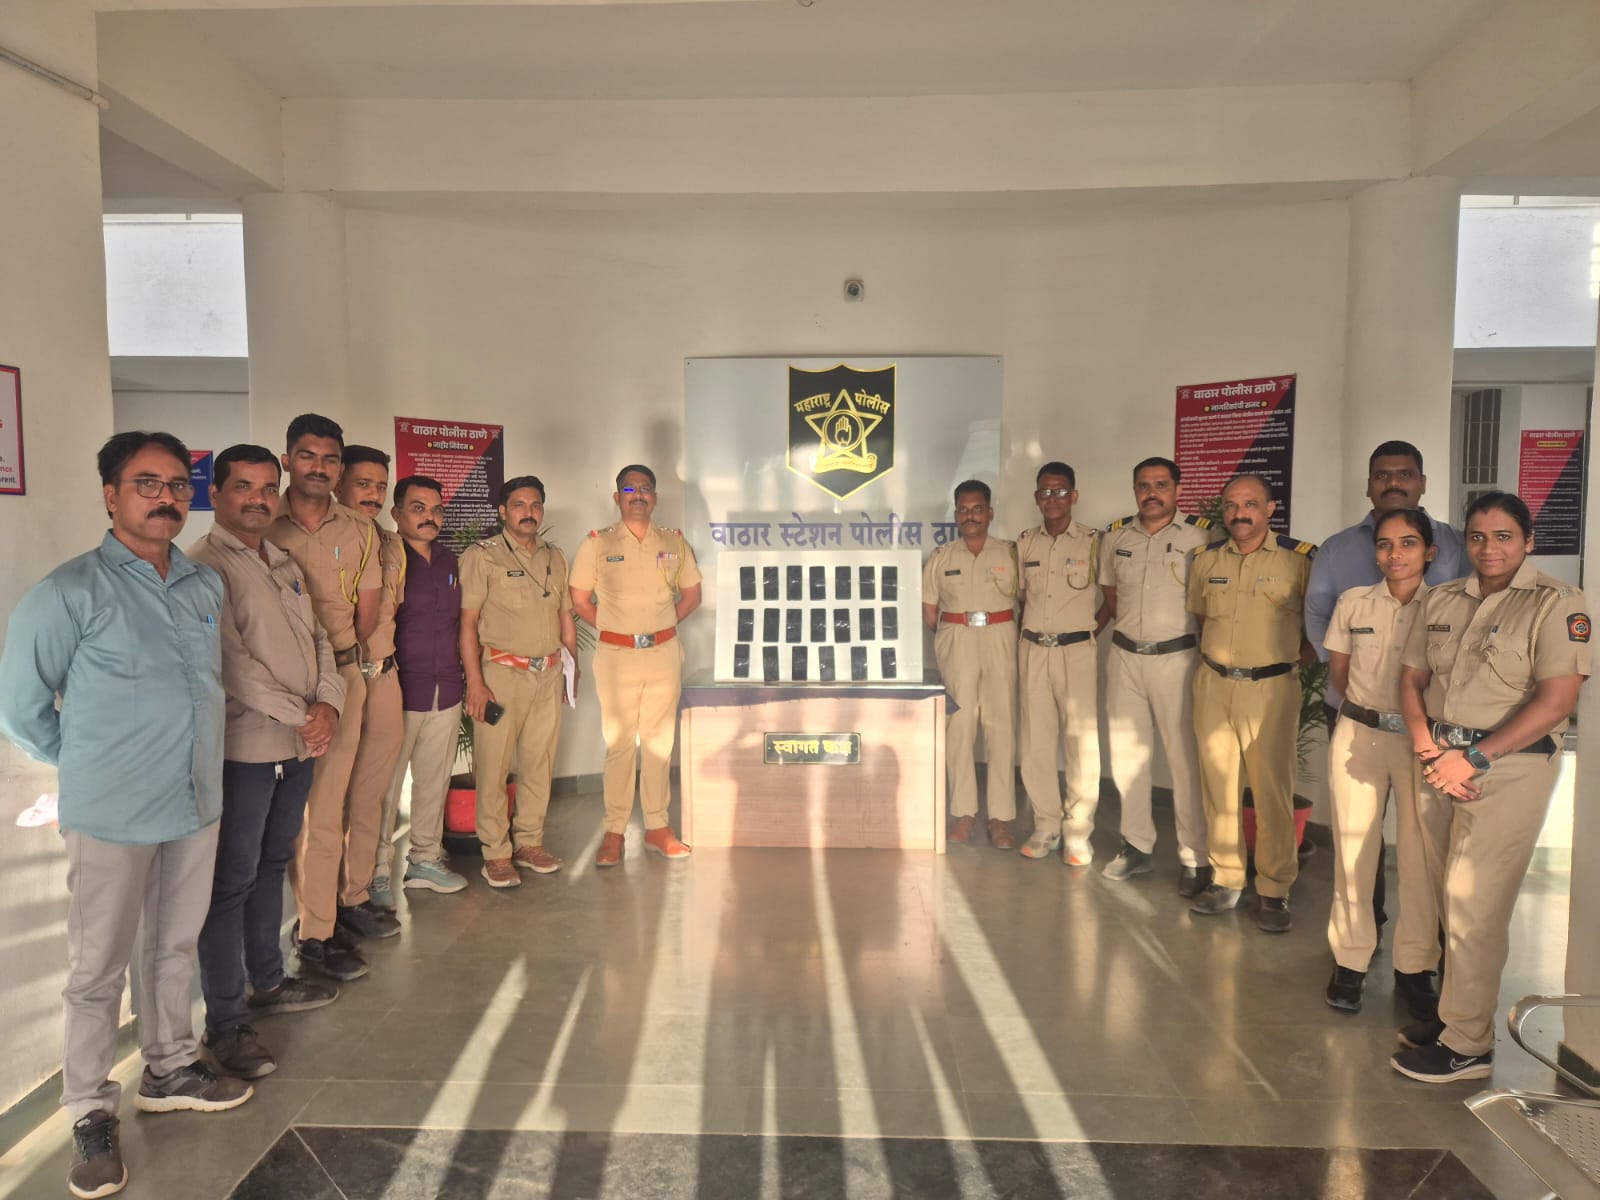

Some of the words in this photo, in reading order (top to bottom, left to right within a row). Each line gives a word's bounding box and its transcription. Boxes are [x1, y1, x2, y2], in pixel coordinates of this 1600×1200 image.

[1193, 388, 1219, 399] वाठार
[1221, 383, 1253, 397] पोलीस
[1254, 381, 1276, 393] ठाणे
[854, 389, 891, 415] पोलीस
[412, 425, 438, 436] वाठार
[439, 425, 468, 438] पोलीस
[469, 428, 488, 439] ठाणे
[709, 522, 771, 546] वाठार
[778, 511, 842, 548] स्टेशन
[849, 511, 922, 546] पोलीस
[772, 740, 820, 755] स्वागत
